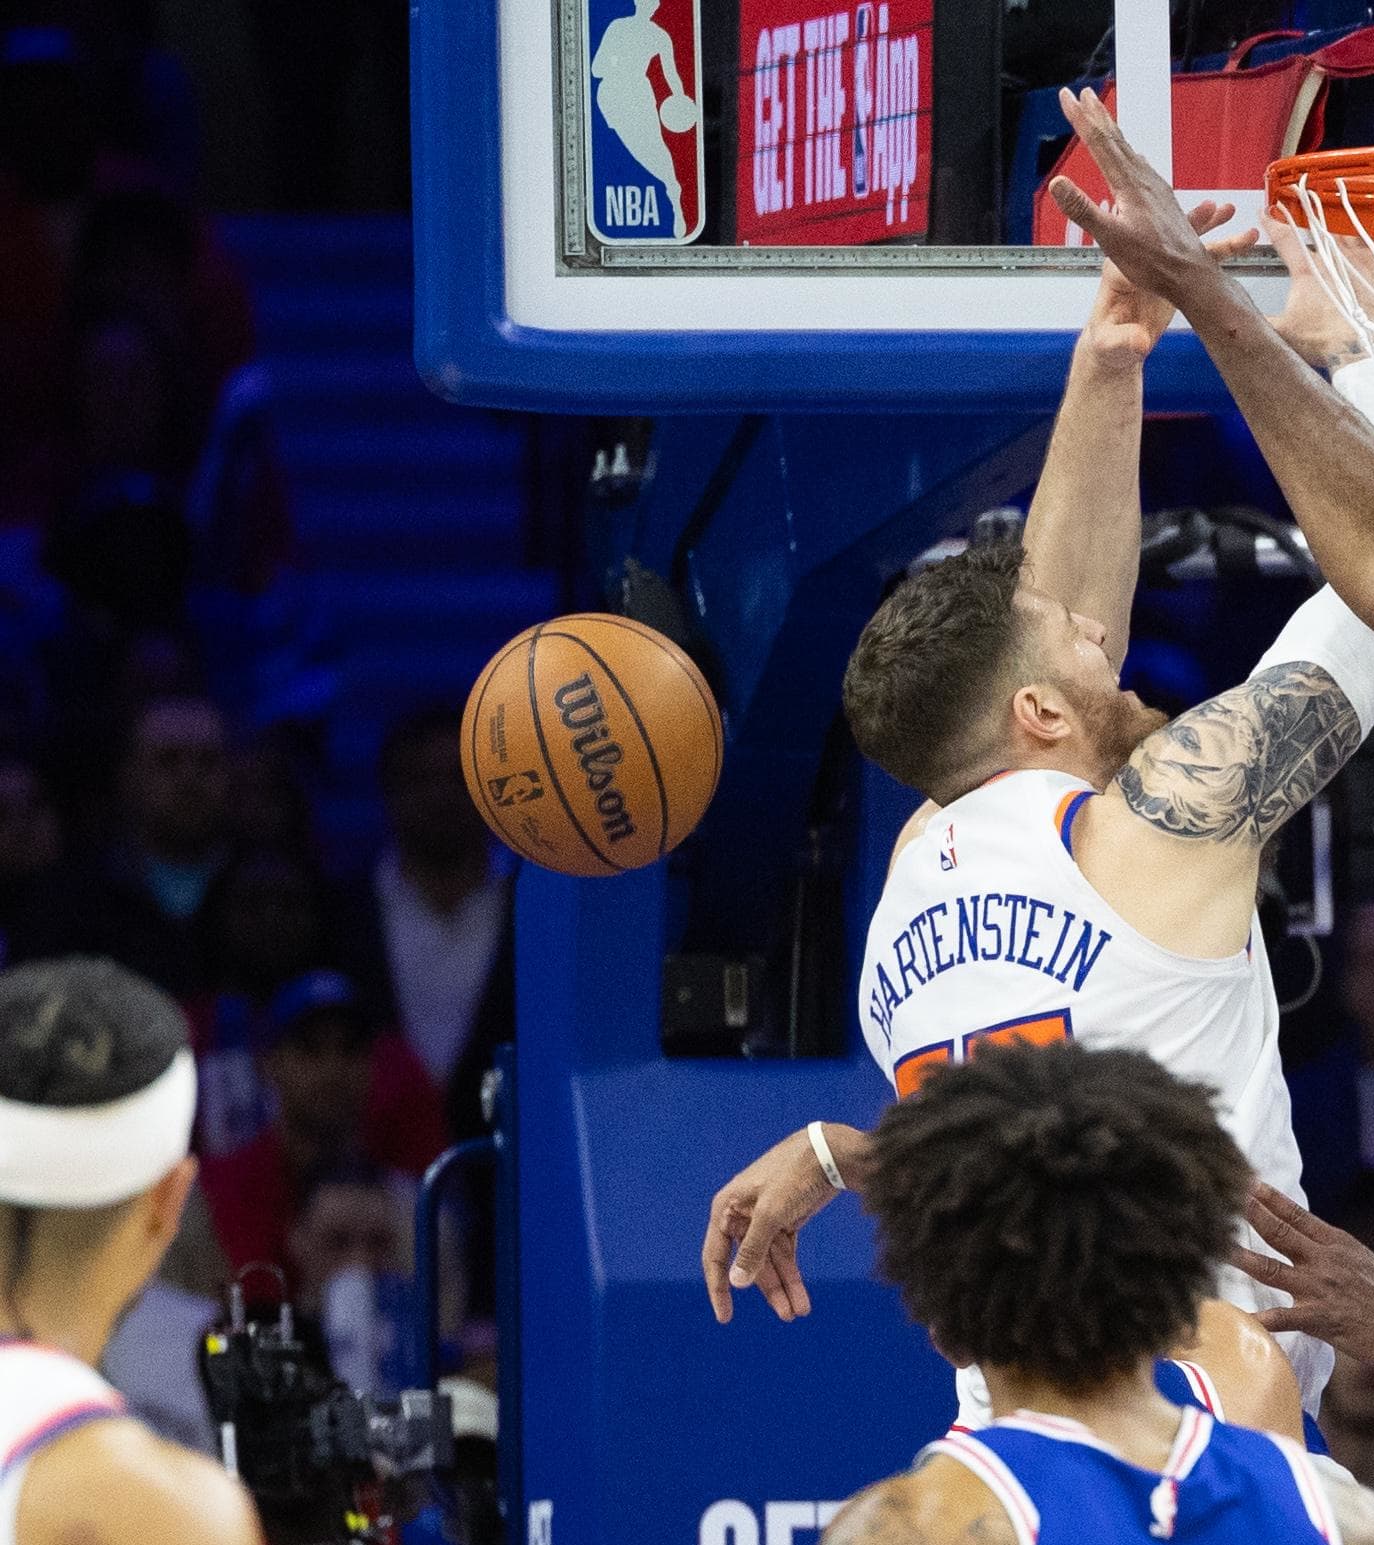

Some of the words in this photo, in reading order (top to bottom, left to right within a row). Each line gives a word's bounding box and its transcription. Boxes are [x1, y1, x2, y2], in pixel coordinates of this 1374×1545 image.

[605, 185, 660, 226] NBA
[554, 670, 636, 843] Wilson
[869, 893, 1113, 1052] HARTENSTEIN
